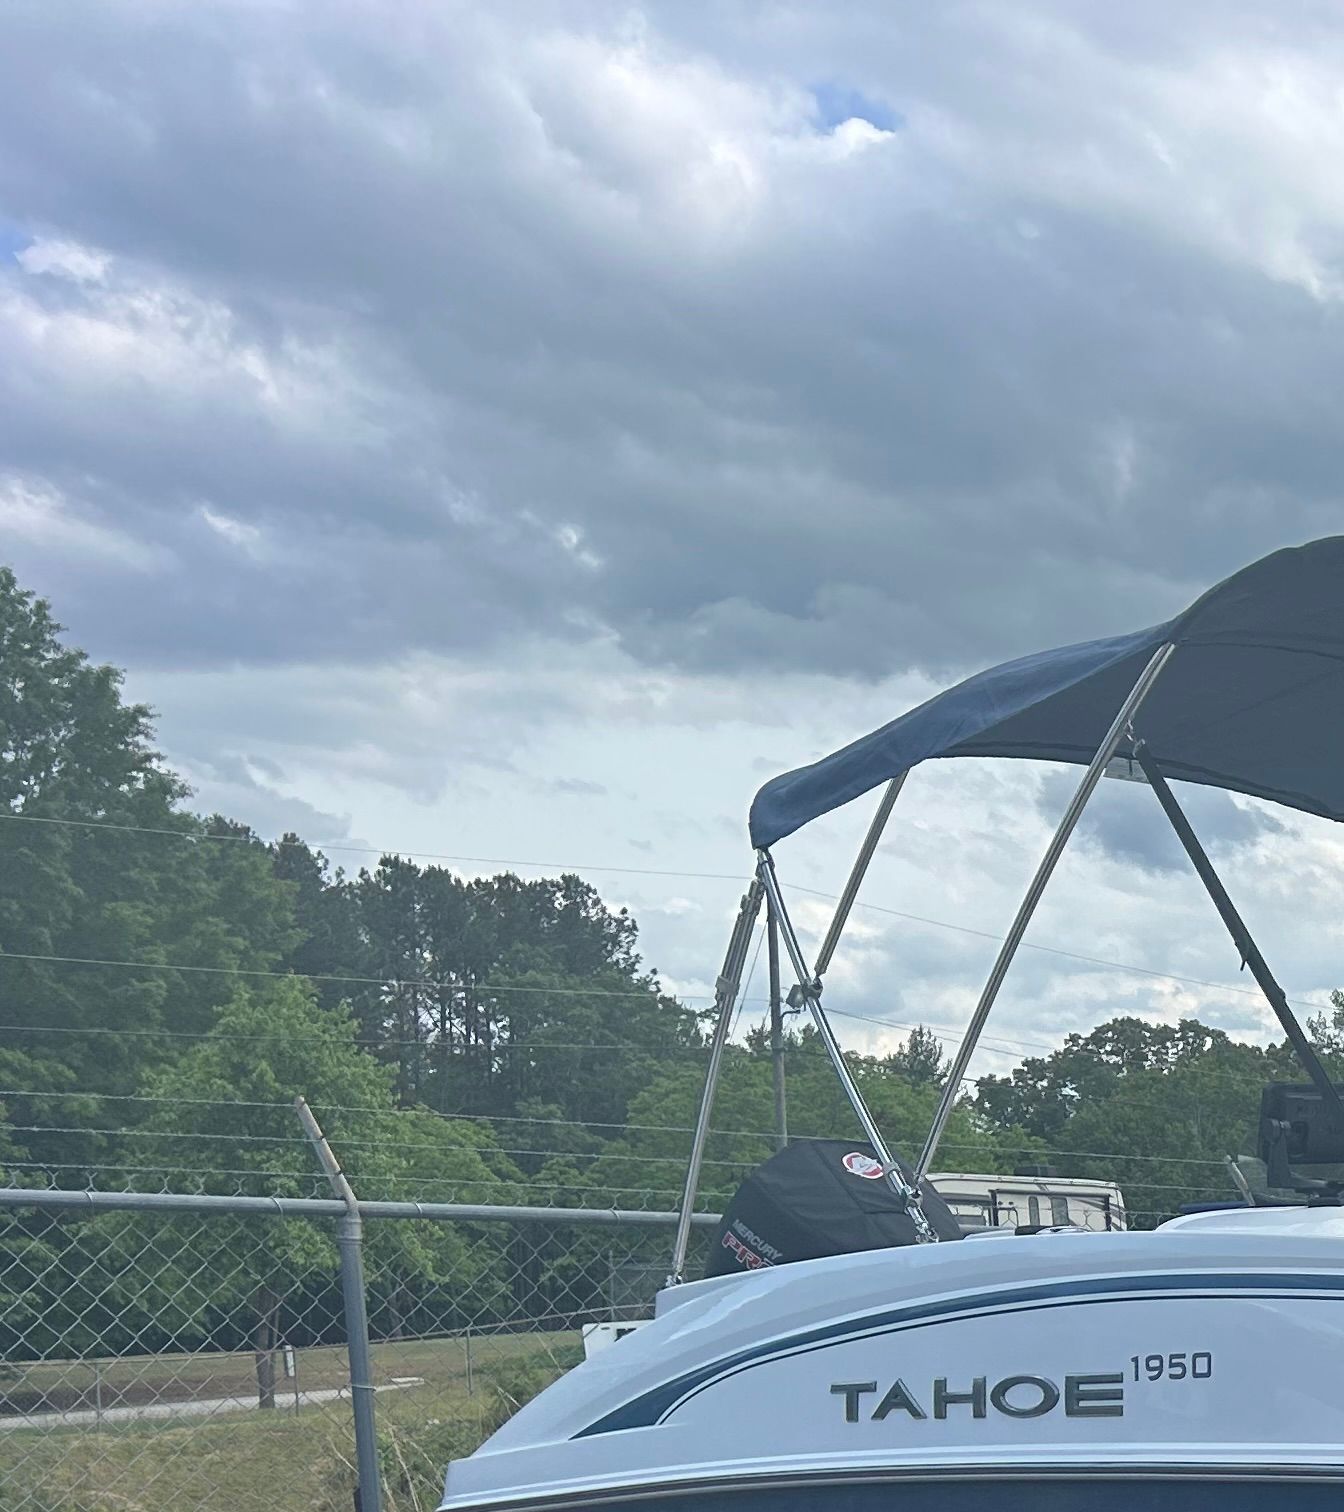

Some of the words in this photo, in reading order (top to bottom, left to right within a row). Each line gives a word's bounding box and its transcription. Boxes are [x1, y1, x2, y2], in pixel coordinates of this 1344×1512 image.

[732, 1219, 783, 1260] MERCURY
[829, 1372, 1125, 1423] TAHOE
[1130, 1351, 1212, 1382] 1950
